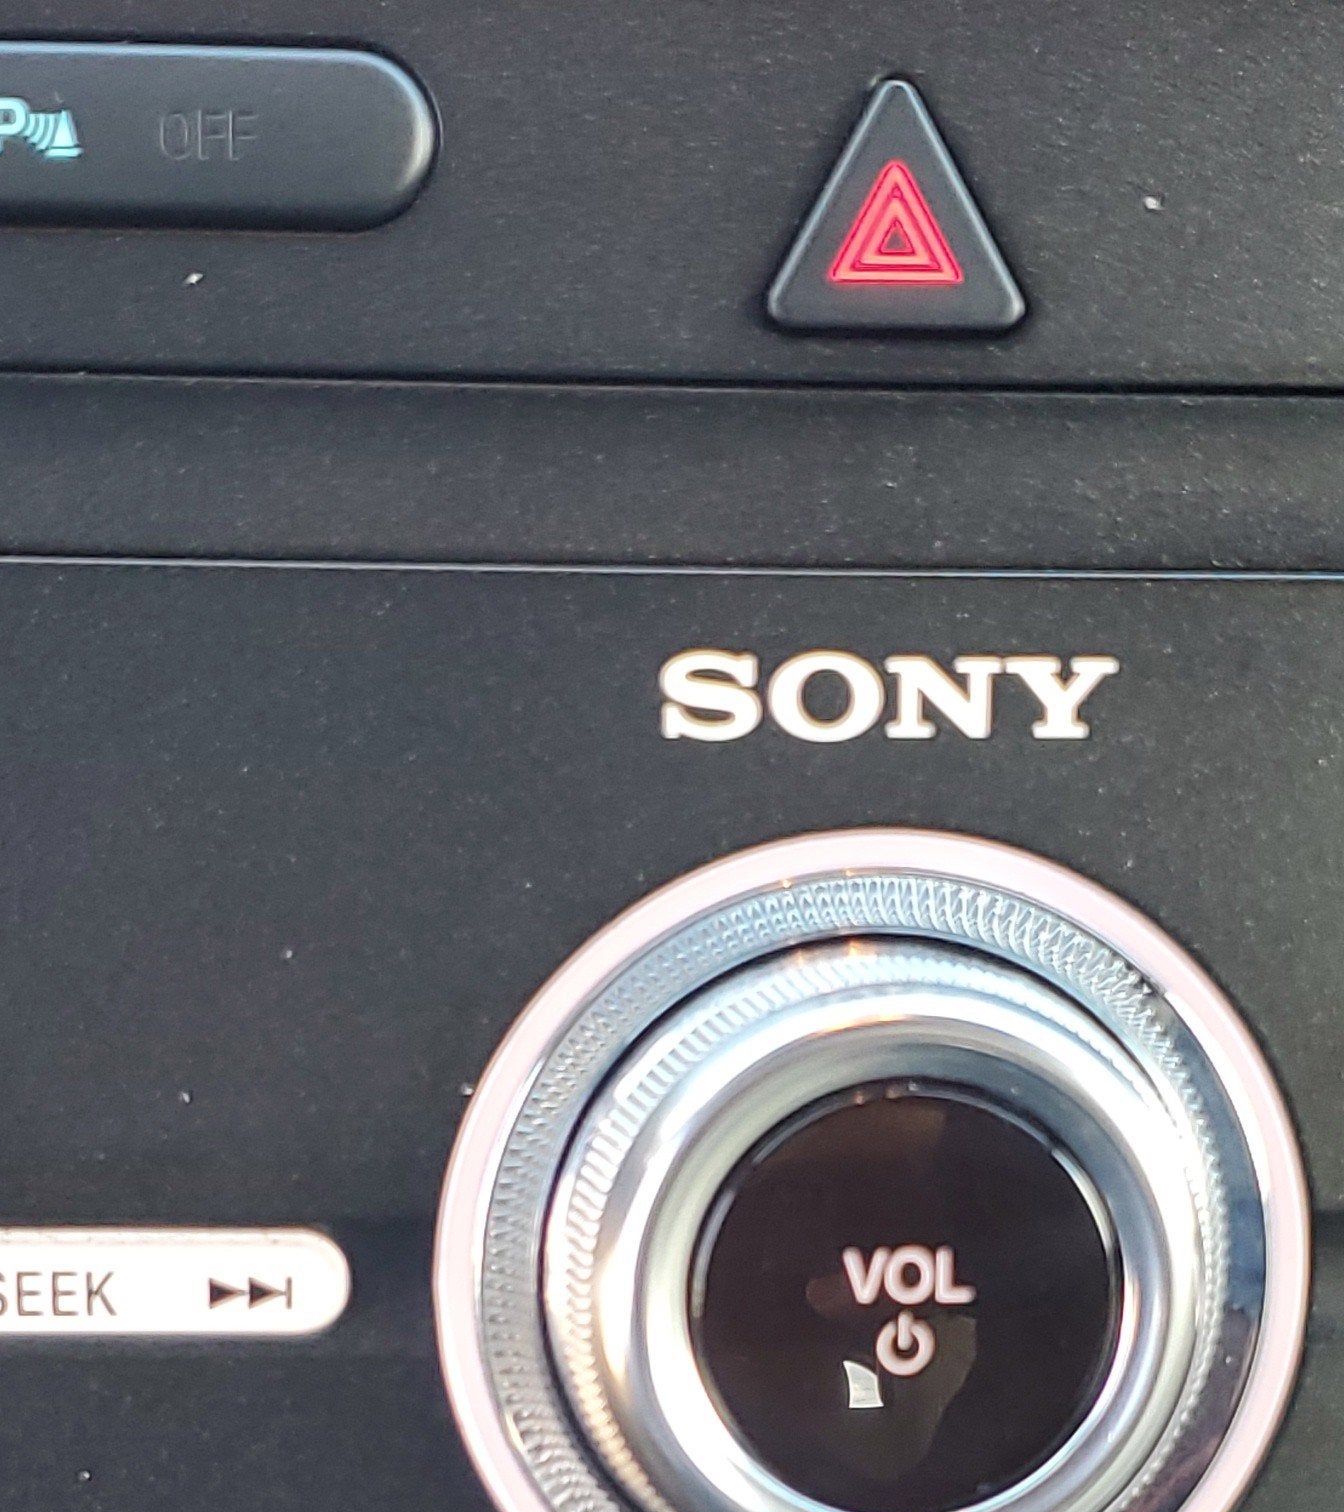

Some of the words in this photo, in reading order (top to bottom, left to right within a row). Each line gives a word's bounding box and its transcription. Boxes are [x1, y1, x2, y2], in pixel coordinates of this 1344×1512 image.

[159, 109, 256, 161] OFF
[659, 647, 1119, 742] SONY
[843, 1244, 976, 1305] VOL
